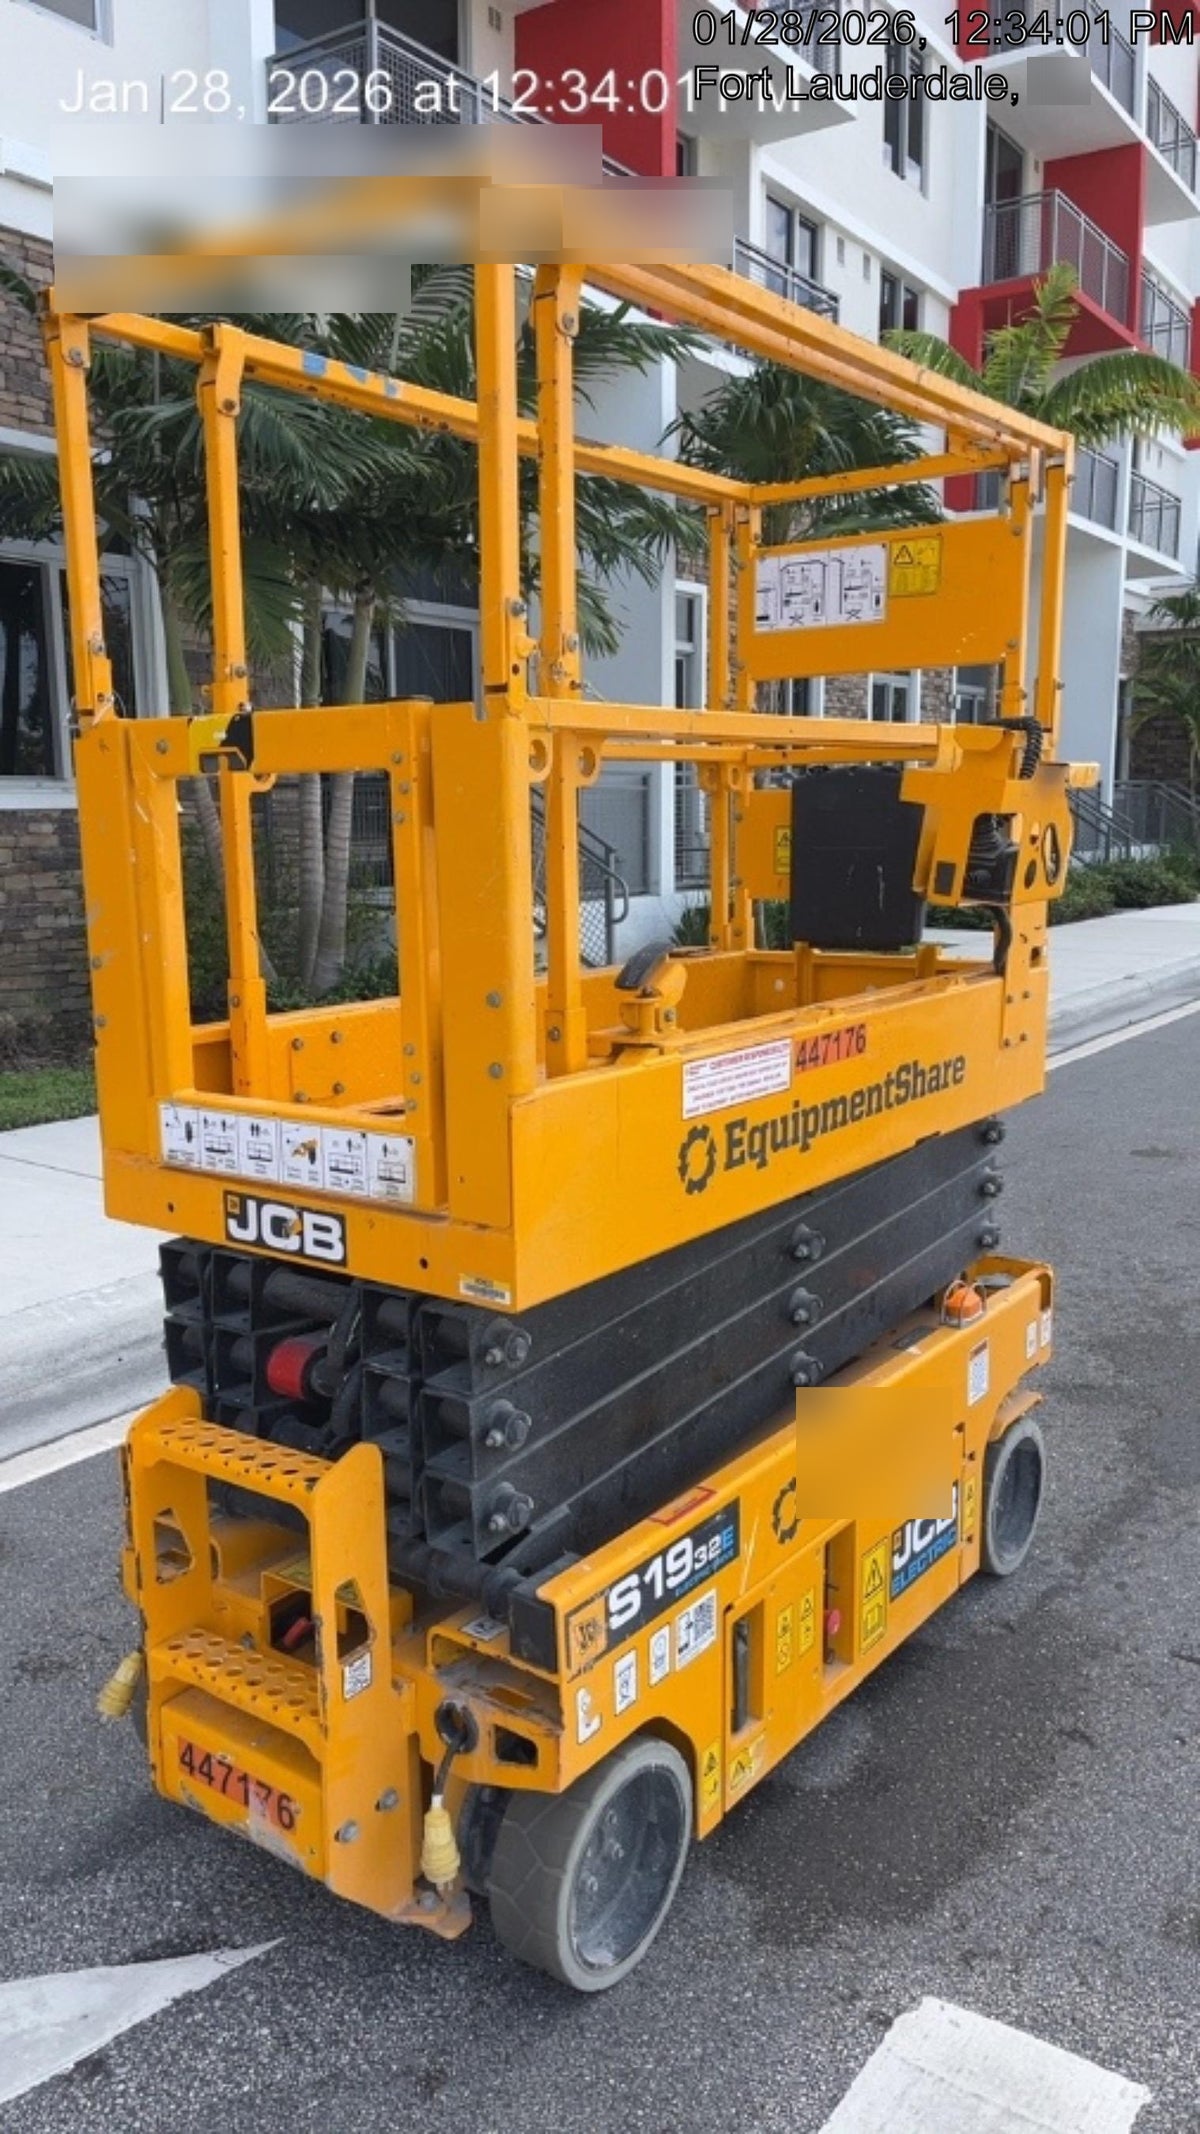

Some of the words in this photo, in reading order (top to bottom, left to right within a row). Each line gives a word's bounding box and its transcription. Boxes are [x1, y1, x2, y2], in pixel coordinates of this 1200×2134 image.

[796, 1024, 866, 1071] 447176
[723, 1055, 966, 1171] EquipmentShare
[227, 1199, 344, 1261] JCB
[180, 1743, 294, 1830] 447176
